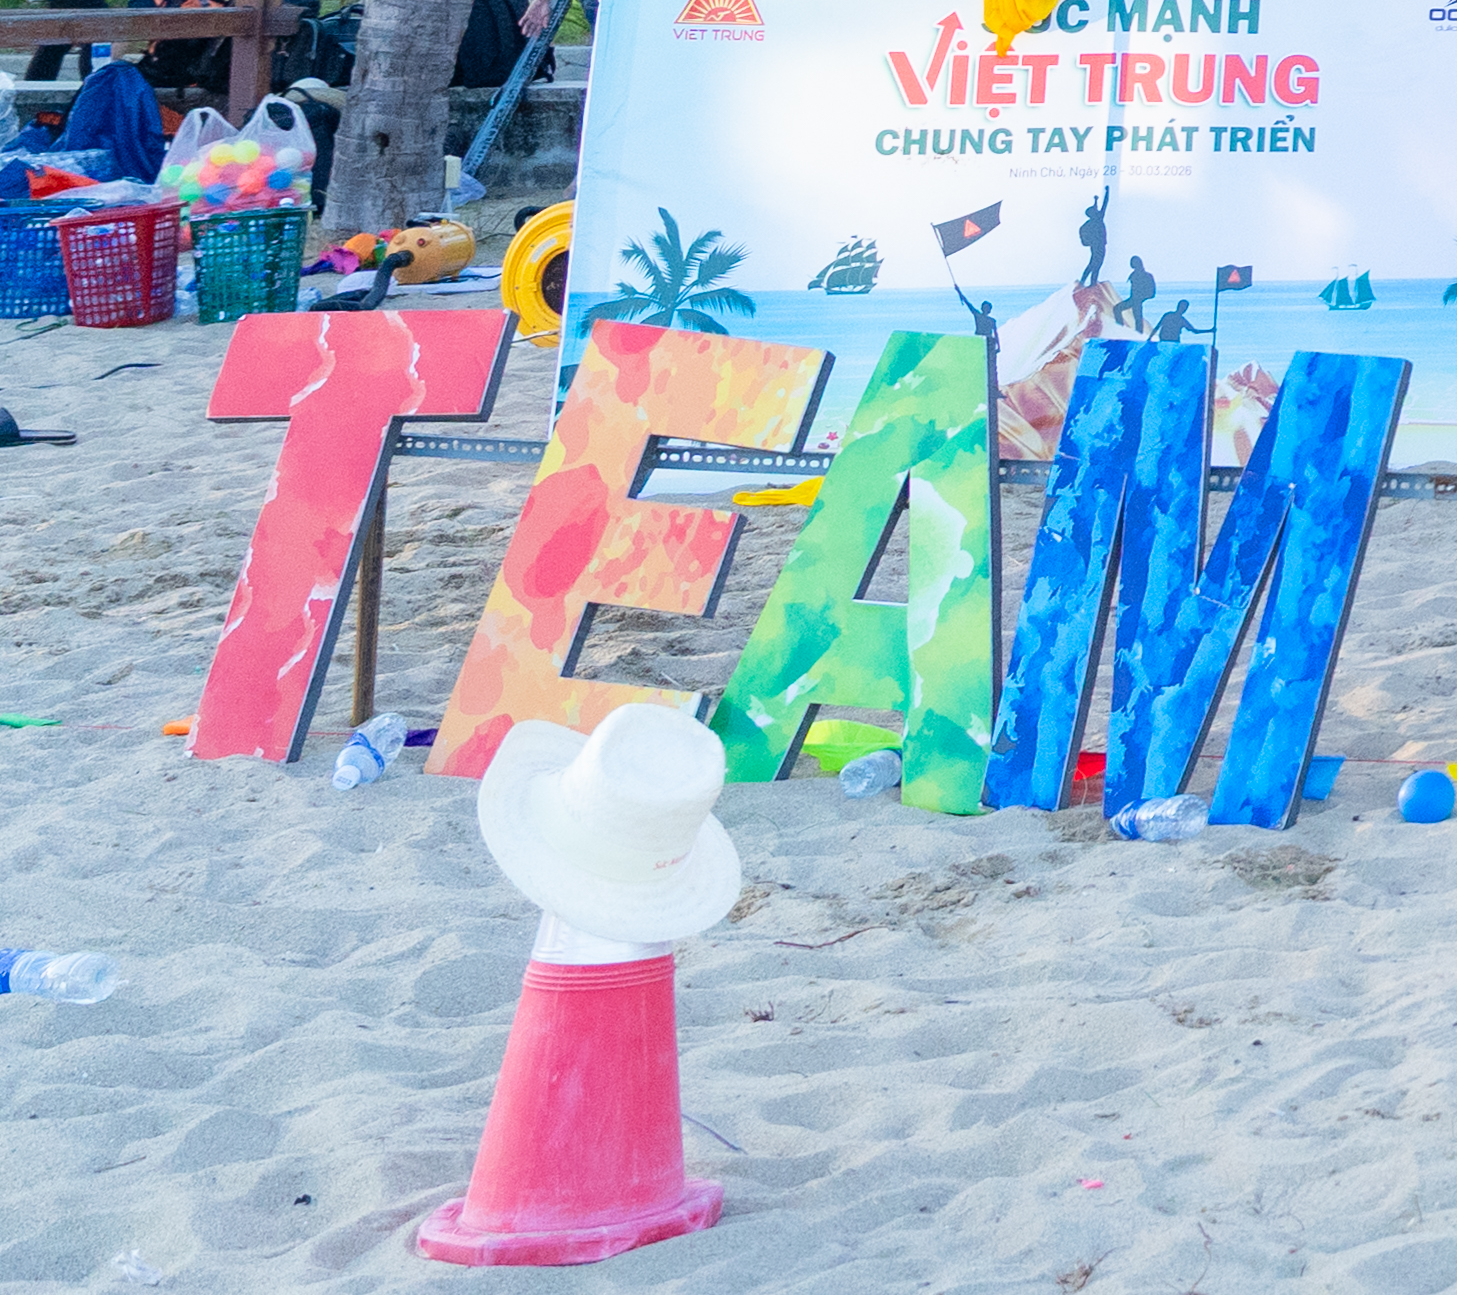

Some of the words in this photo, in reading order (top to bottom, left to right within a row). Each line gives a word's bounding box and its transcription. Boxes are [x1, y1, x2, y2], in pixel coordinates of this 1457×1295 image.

[712, 29, 765, 41] TRUNG
[1079, 53, 1321, 104] TRUNG
[875, 127, 1014, 156] CHUNG
[1027, 126, 1094, 154] TAY
[1106, 118, 1199, 152] PHÁT
[1209, 115, 1316, 153] TRIỂN
[1009, 167, 1037, 178] Ninh
[1103, 165, 1118, 176] 28
[1128, 165, 1192, 177] 30.03.2026
[186, 308, 1411, 829] TEAM
